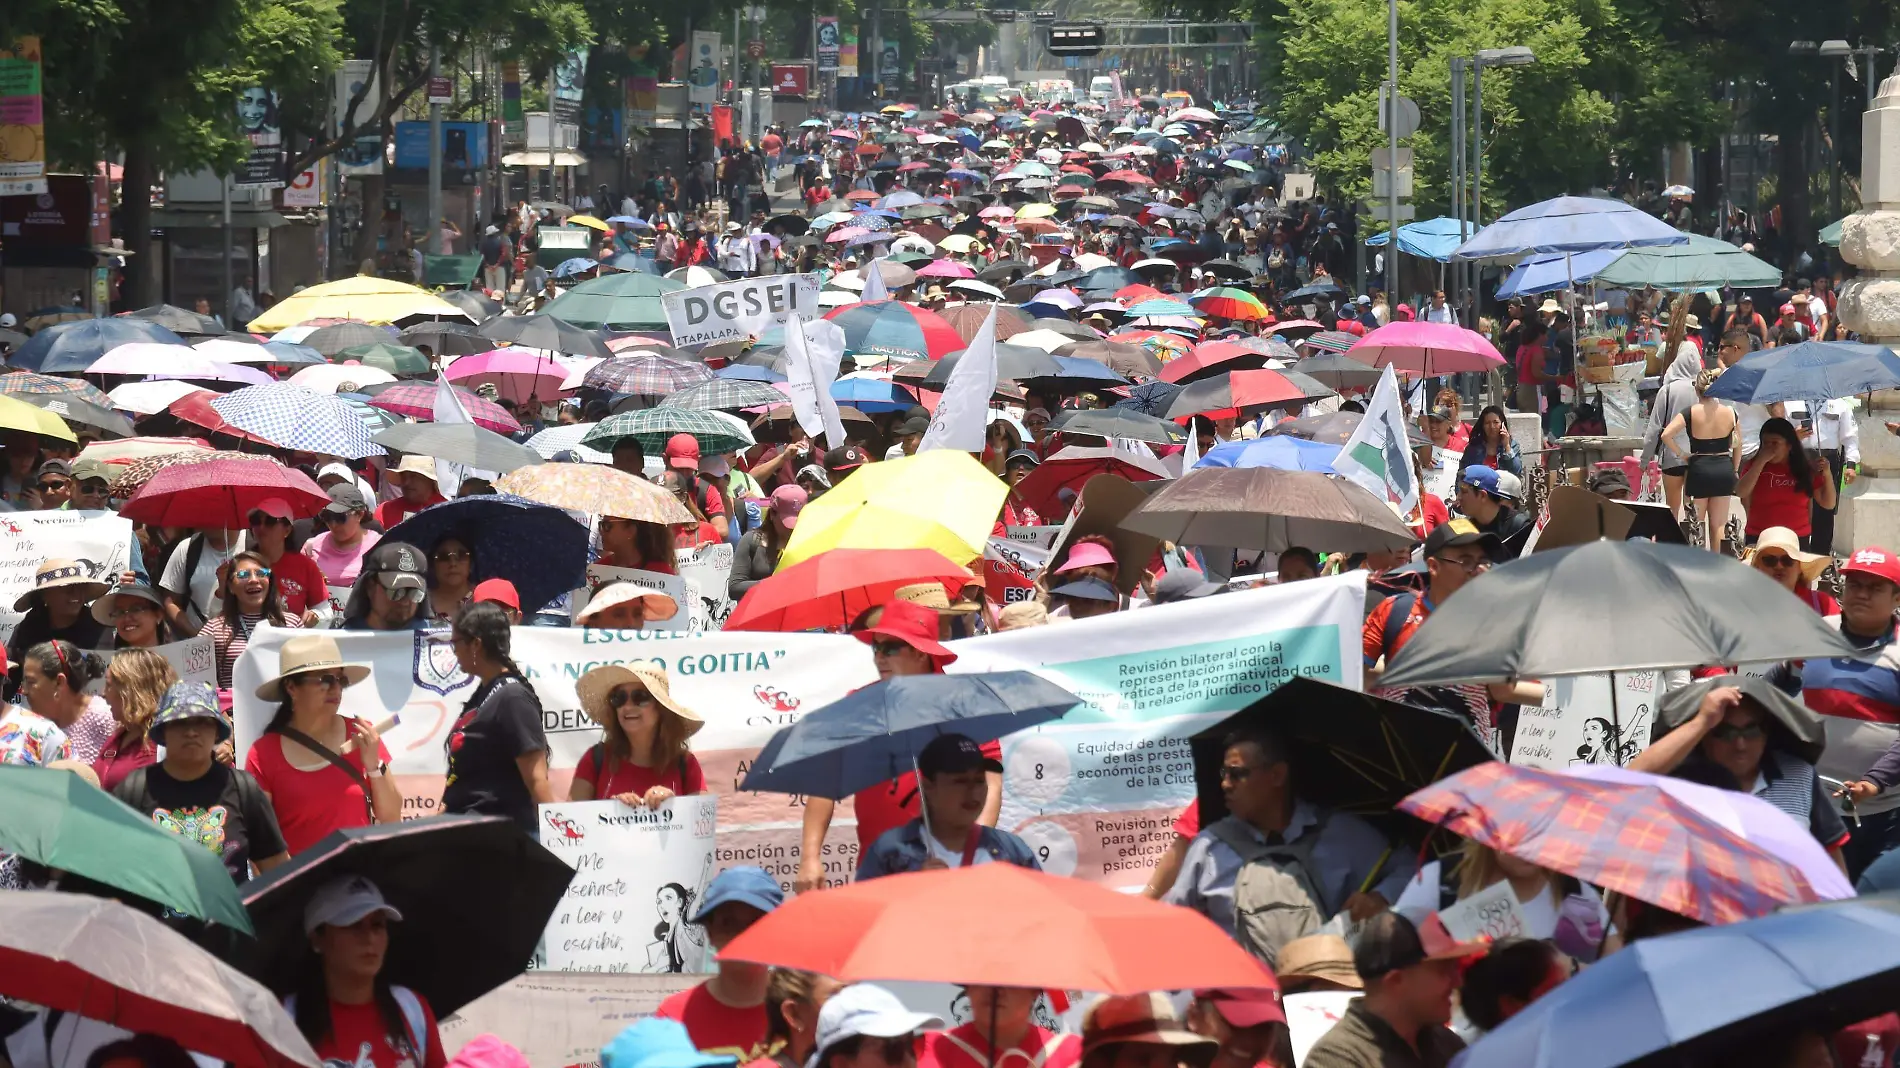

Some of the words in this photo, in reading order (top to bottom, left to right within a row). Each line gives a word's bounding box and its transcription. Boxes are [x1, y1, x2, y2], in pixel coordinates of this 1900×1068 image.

[684, 282, 797, 326] DGSEI
[870, 344, 920, 358] NAUTICA
[658, 580, 666, 590] 9
[1119, 658, 1178, 677] Revisión
[1181, 648, 1237, 668] bilateral
[1240, 644, 1266, 656] con
[1269, 640, 1282, 652] la
[1120, 663, 1224, 689] representación
[1228, 653, 1283, 670] sindical
[1167, 682, 1184, 694] de
[1188, 678, 1200, 690] la
[1202, 666, 1300, 687] normatividad
[1302, 662, 1330, 678] que
[1204, 683, 1262, 700] jurídico
[1626, 677, 1653, 692] 2024
[1077, 740, 1134, 756] Equidad
[1137, 738, 1154, 750] de
[1103, 754, 1120, 764] de
[1124, 752, 1144, 762] las
[1035, 763, 1044, 780] 8
[1077, 763, 1162, 778] económicas
[1166, 762, 1192, 772] con
[1126, 777, 1144, 788] de
[1148, 776, 1160, 786] la
[598, 806, 658, 826] Sección
[662, 808, 673, 824] 9
[1096, 818, 1156, 832] Revisión
[1102, 832, 1134, 848] para
[716, 842, 784, 861] tención
[1038, 846, 1050, 862] 9
[576, 852, 604, 872] Me
[566, 878, 628, 898] nseñaste
[560, 910, 570, 924] a
[576, 906, 606, 924] leer
[1479, 898, 1510, 921] 989
